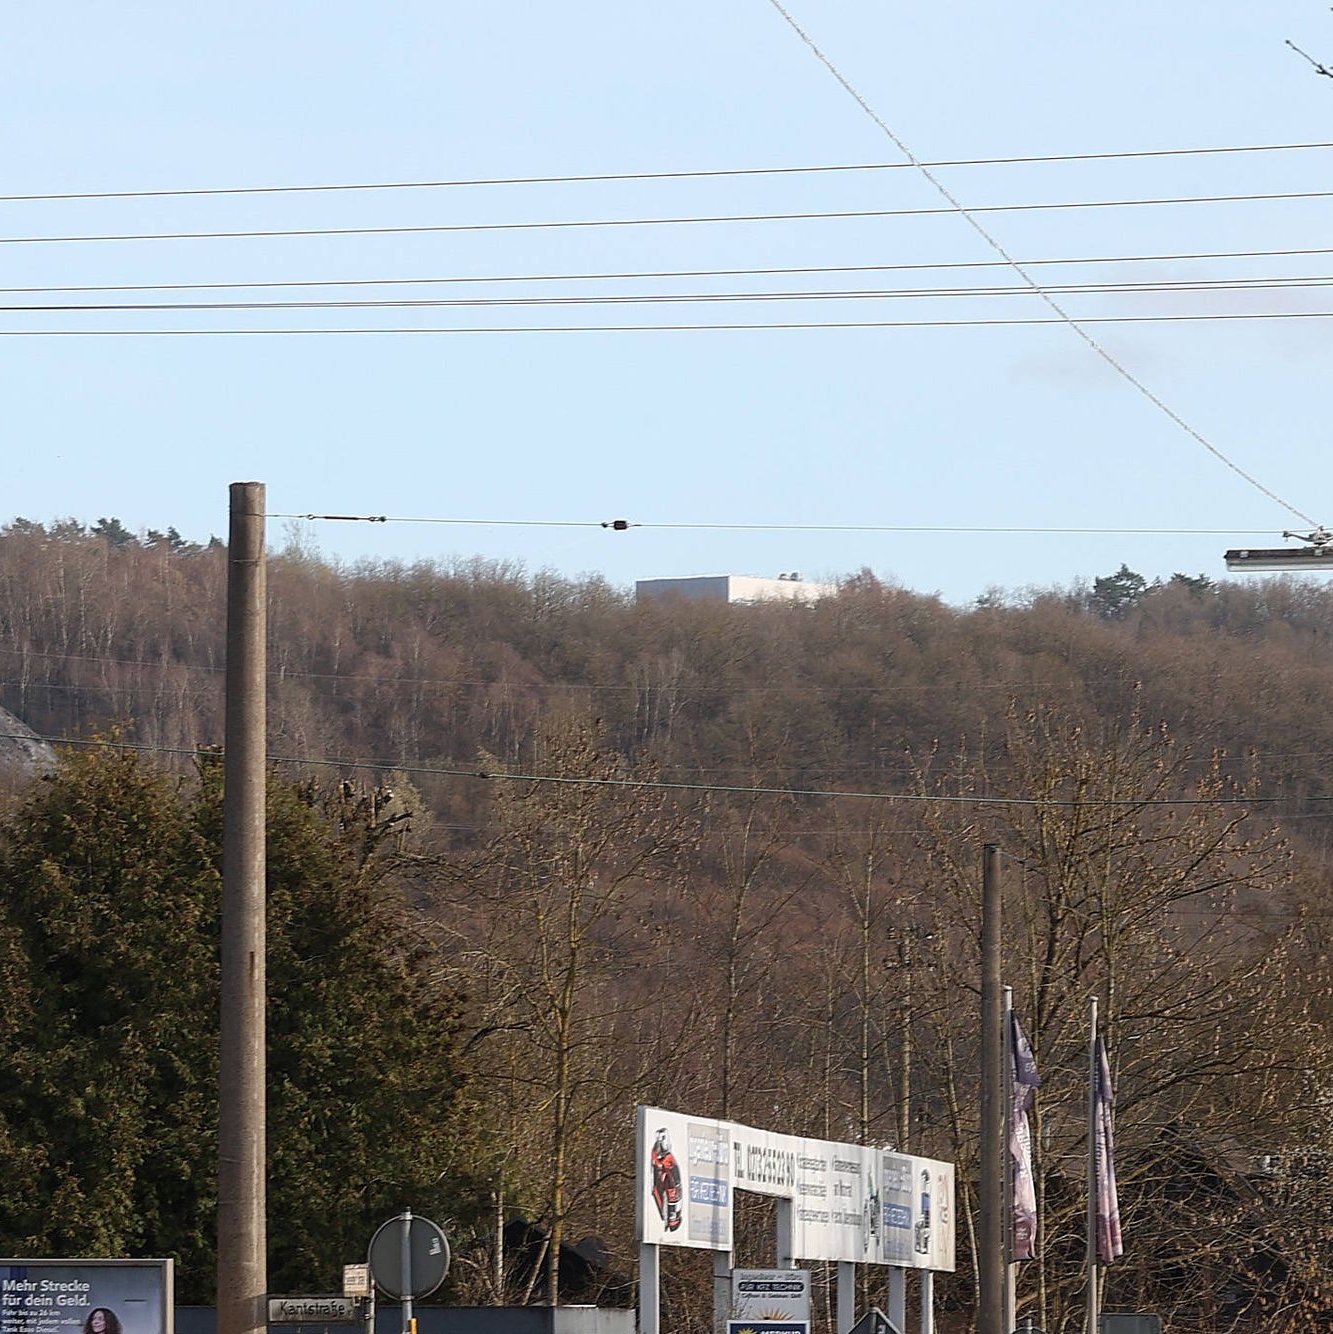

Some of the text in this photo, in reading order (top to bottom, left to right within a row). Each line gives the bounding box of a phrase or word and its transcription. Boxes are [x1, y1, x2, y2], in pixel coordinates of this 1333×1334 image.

[2, 1279, 91, 1292] Mehr Strecke
[1, 1293, 91, 1306] für dein Geld.
[280, 1300, 346, 1317] Kantstraße
